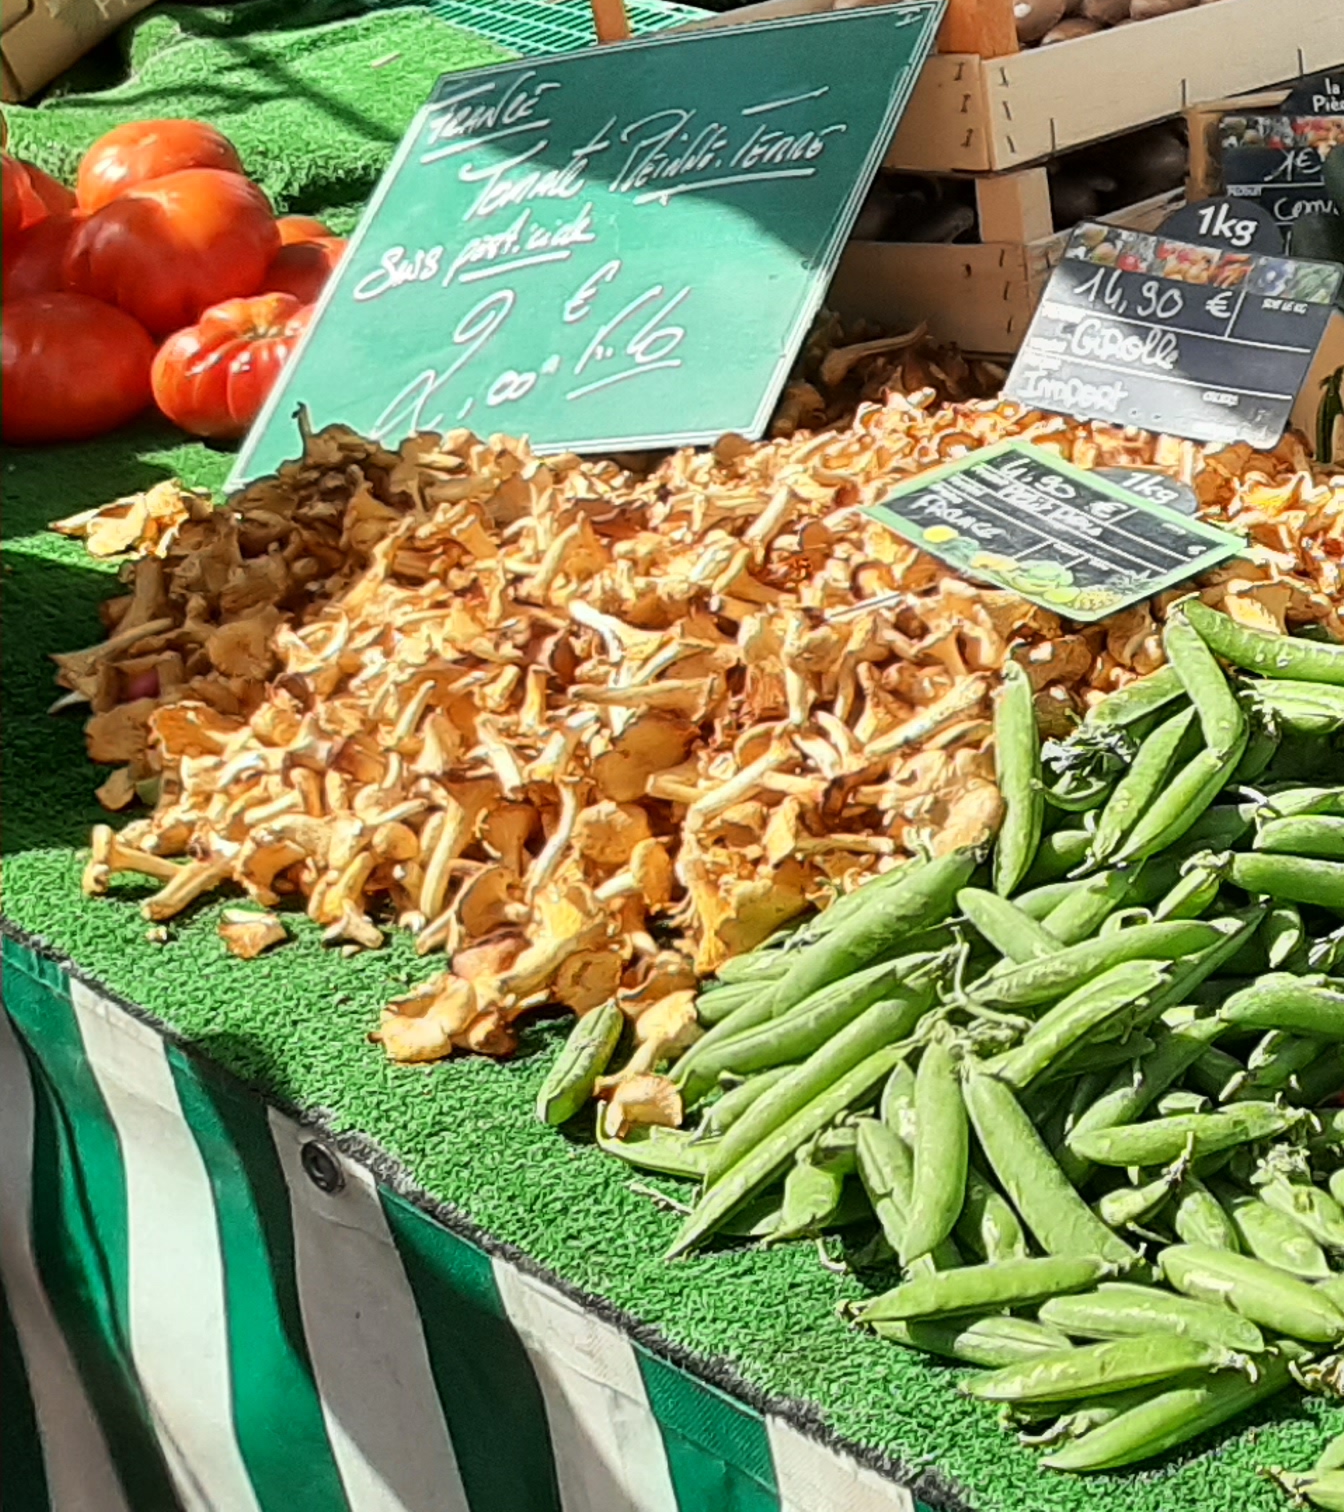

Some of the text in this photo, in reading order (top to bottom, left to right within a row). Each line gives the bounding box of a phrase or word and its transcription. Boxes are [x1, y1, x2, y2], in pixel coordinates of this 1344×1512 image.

[1324, 77, 1341, 95] la
[1198, 203, 1258, 247] 1kg
[1073, 266, 1233, 319] 14,90 €
[1119, 471, 1180, 506] 1kg
[1084, 499, 1129, 520] €
